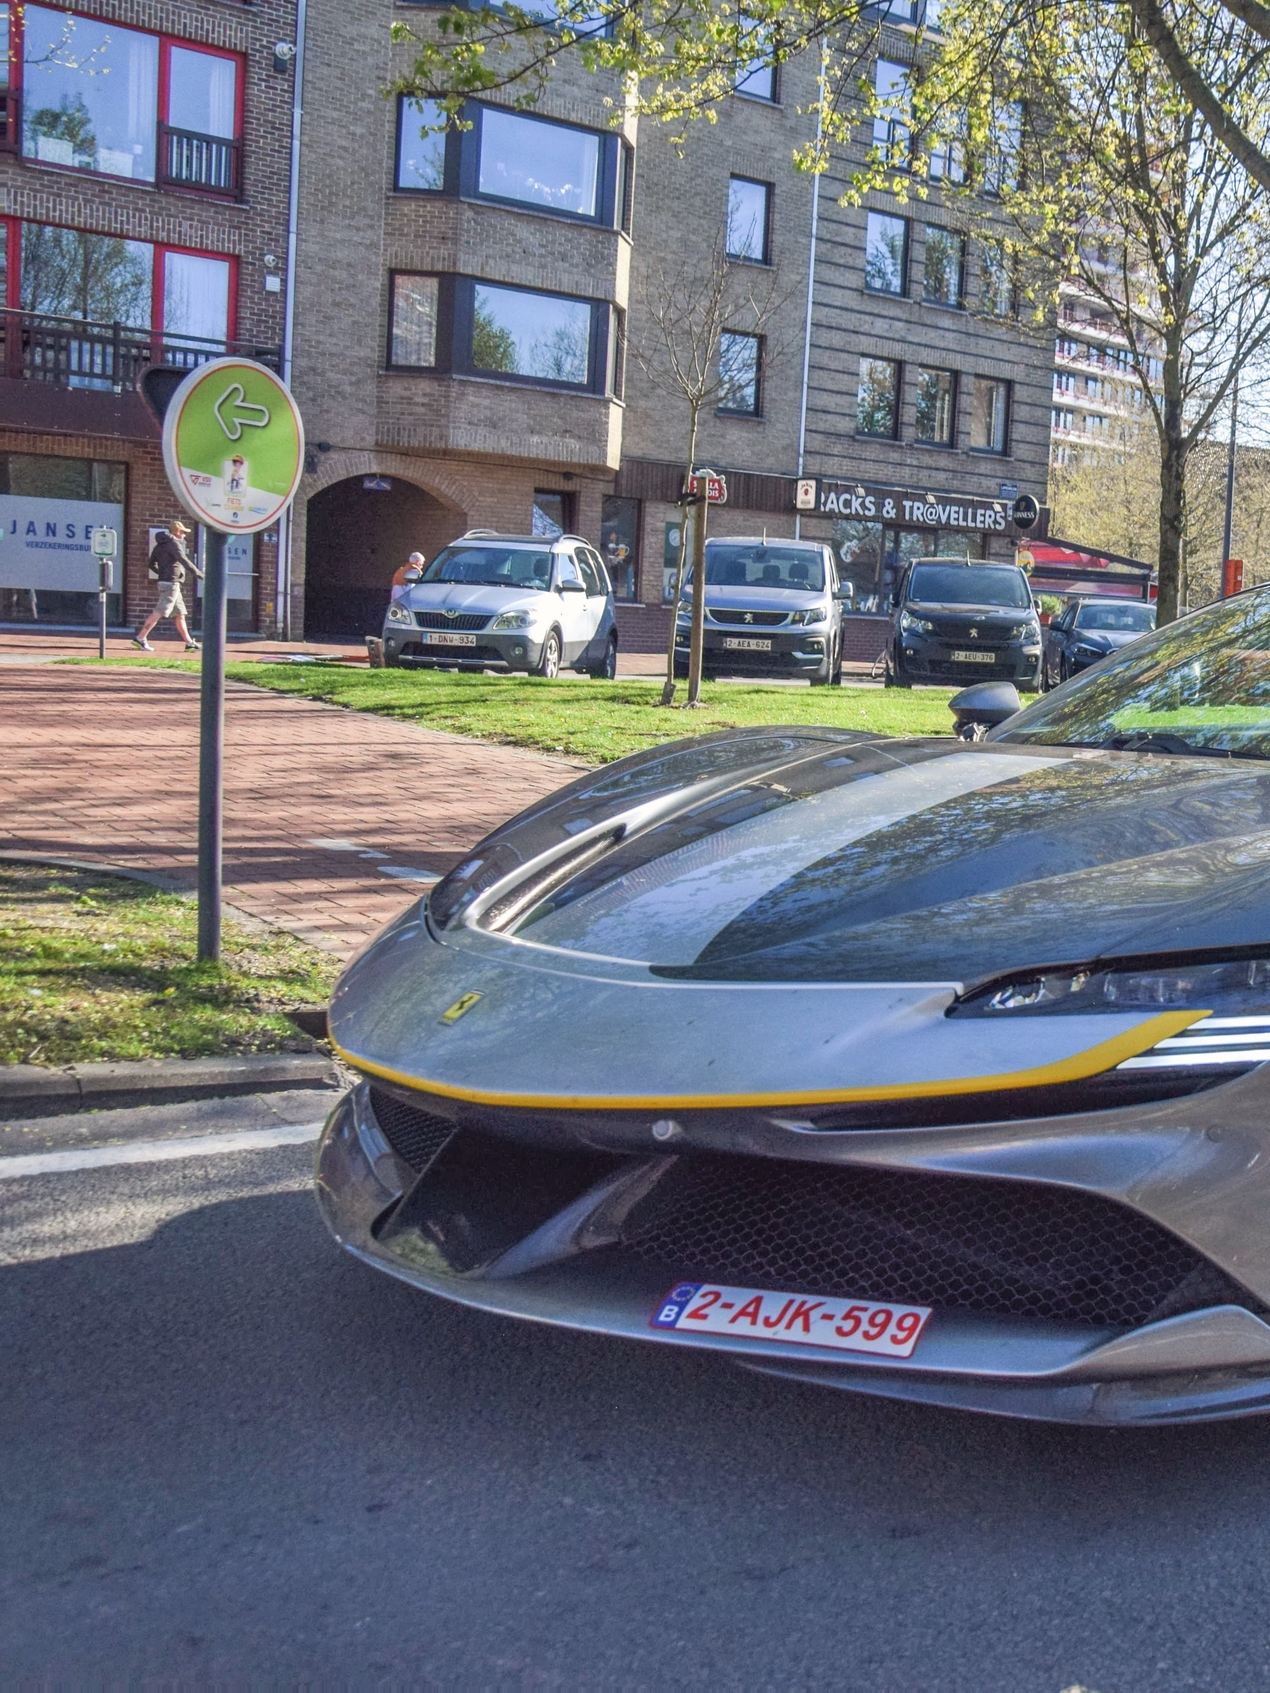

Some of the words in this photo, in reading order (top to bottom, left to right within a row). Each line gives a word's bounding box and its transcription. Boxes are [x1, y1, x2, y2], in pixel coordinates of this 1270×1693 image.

[882, 498, 897, 519] &
[902, 500, 1006, 531] TR@VELLERS
[10, 519, 113, 540] JANSE
[429, 634, 475, 645] 1-DNW-934
[727, 639, 770, 649] 2-AEA-624
[658, 1304, 679, 1322] B
[685, 1290, 921, 1346] 2-AJK-599
